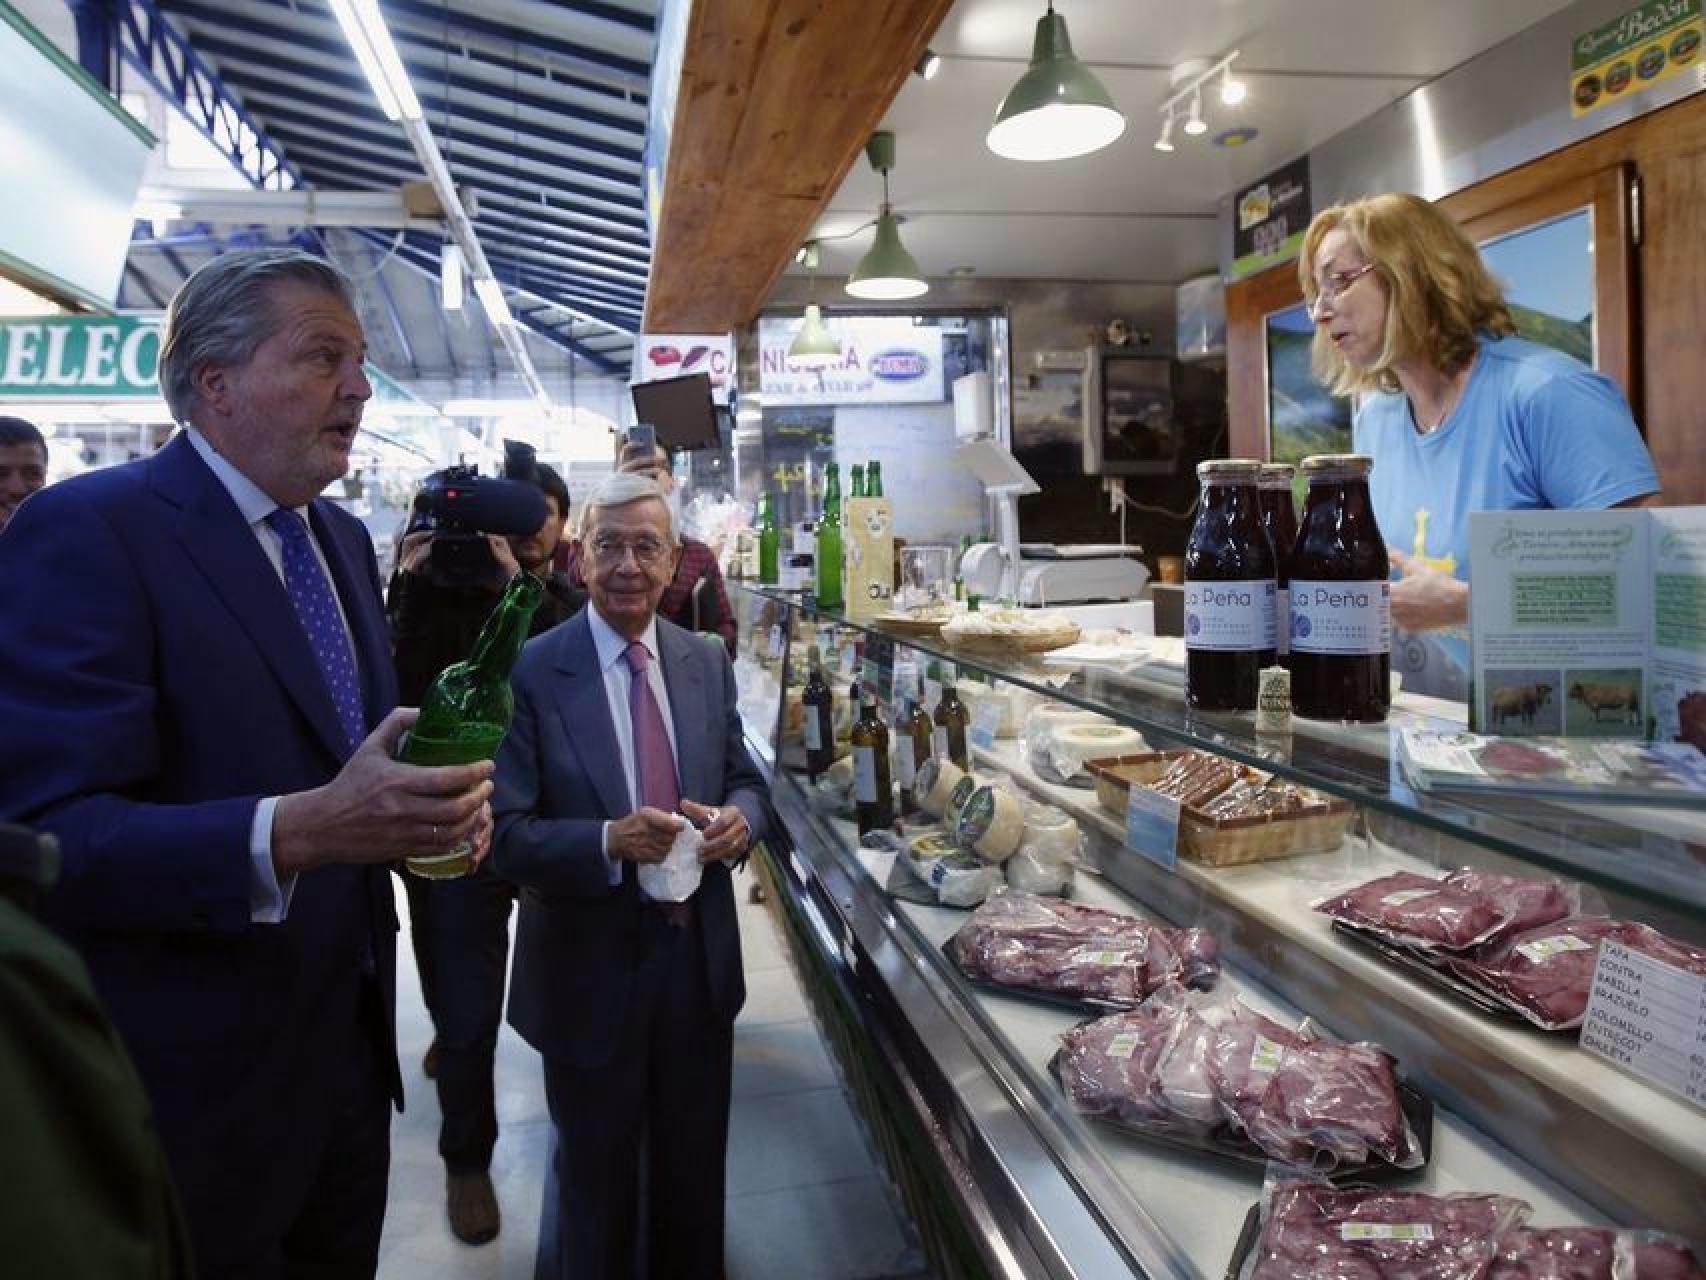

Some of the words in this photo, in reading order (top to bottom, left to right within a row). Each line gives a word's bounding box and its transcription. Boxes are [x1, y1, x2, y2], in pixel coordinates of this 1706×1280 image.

[1203, 588, 1251, 607] Peña
[1315, 587, 1369, 608] Peña
[1600, 959, 1642, 982] CONTRA
[1589, 1007, 1653, 1042] SOLOMILLO
